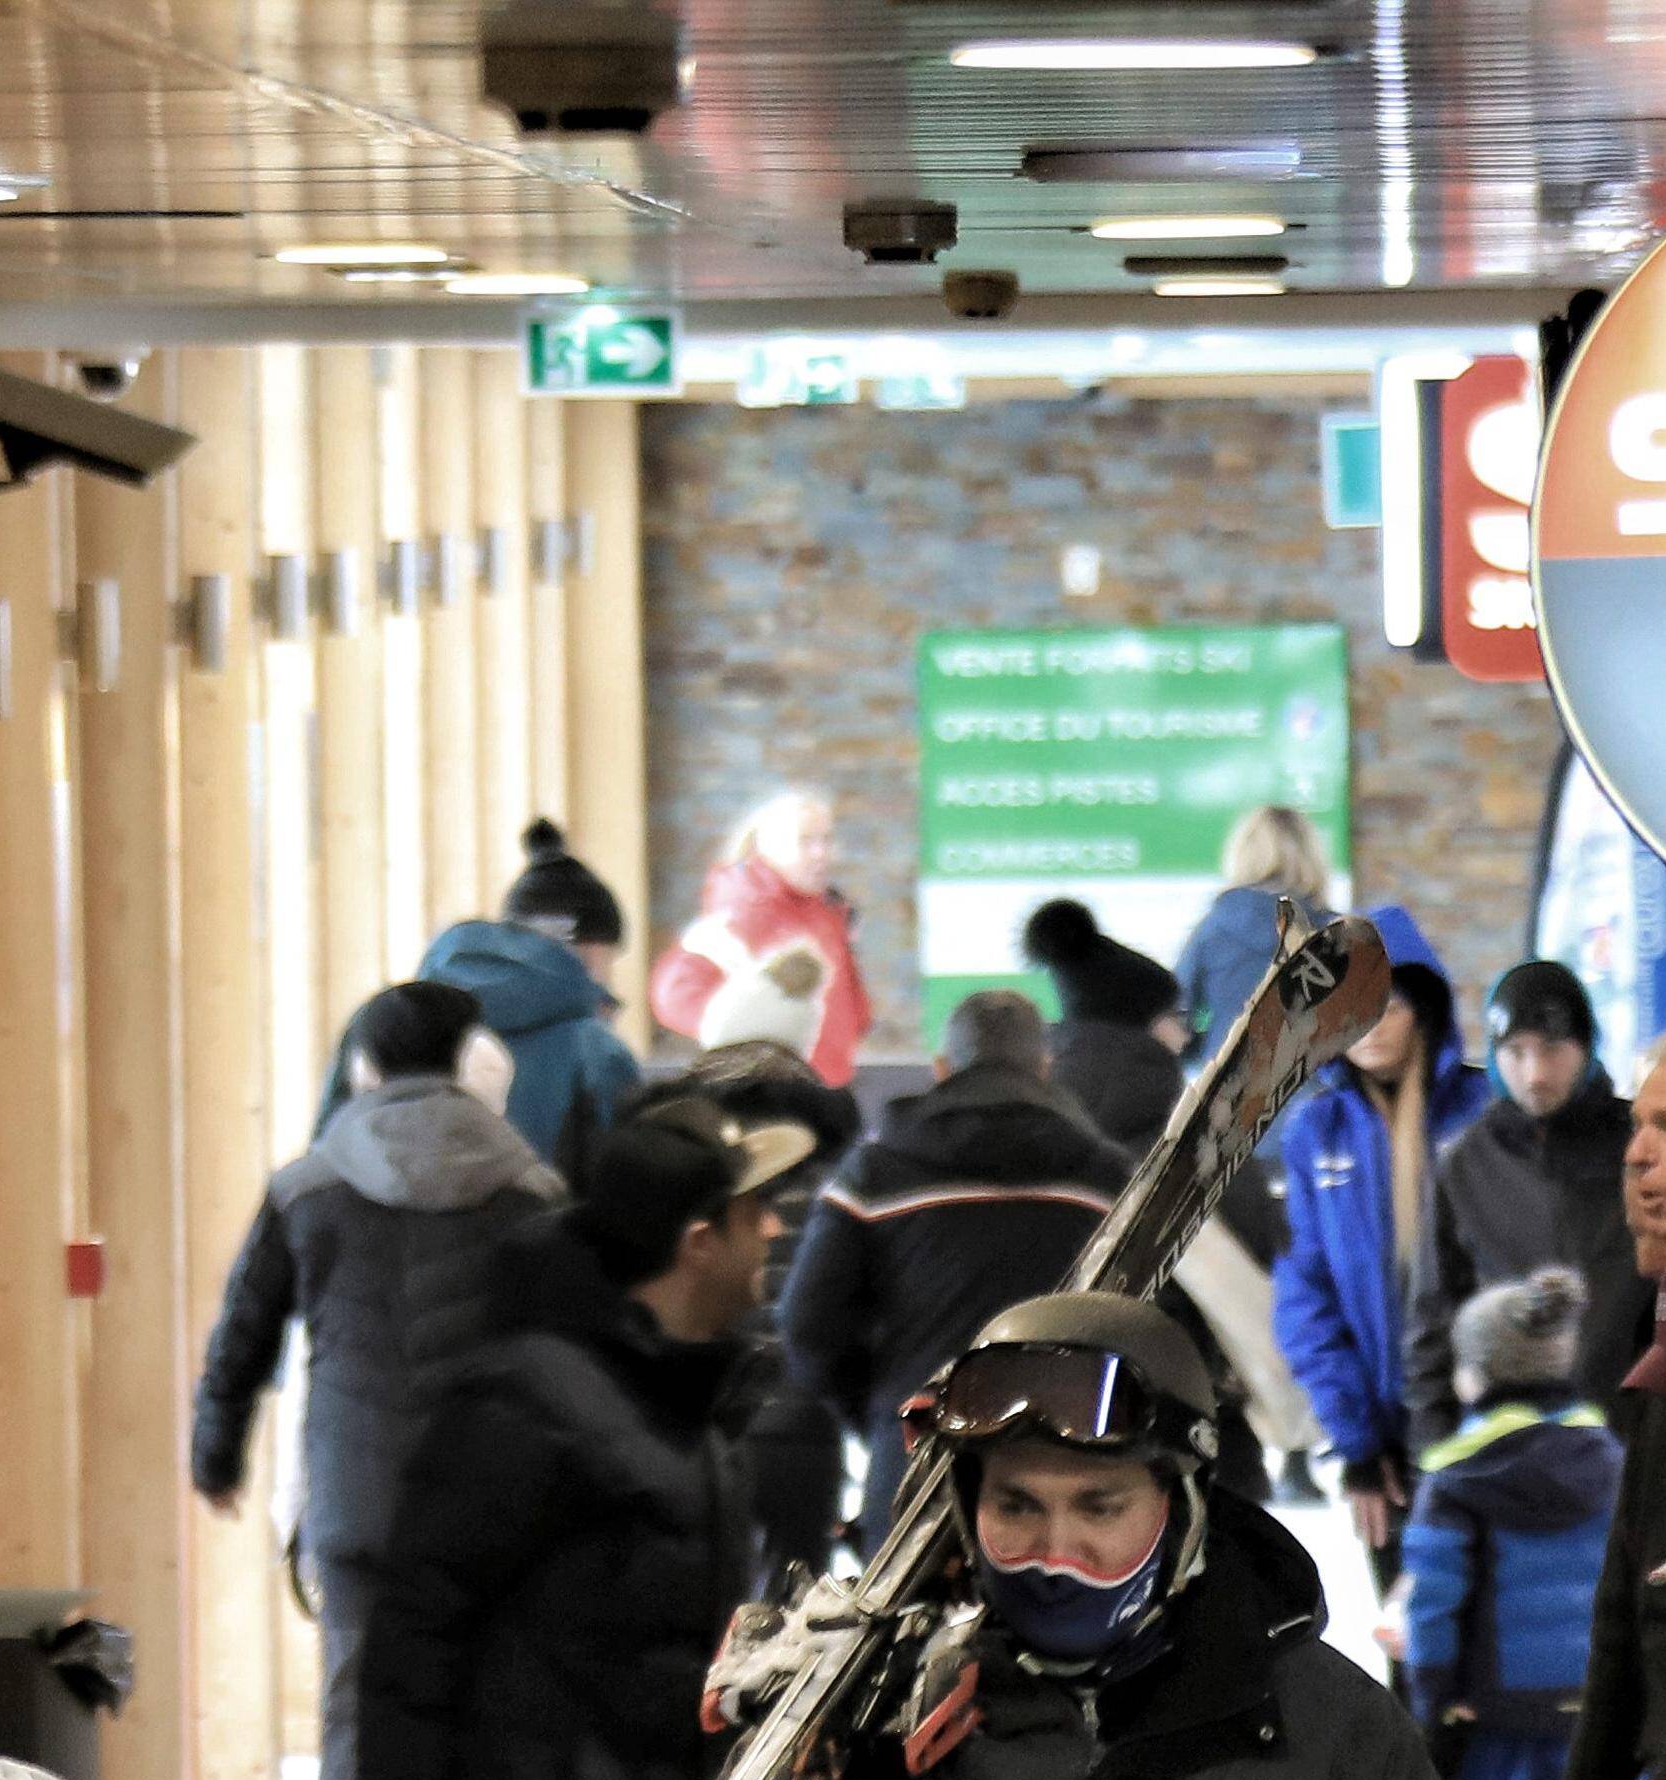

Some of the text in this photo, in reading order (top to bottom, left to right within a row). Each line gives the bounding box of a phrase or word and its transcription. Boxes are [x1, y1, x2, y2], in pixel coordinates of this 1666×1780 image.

[934, 709, 1049, 743] OFFICE
[1053, 709, 1101, 742] DU
[1049, 773, 1161, 806] PISTES
